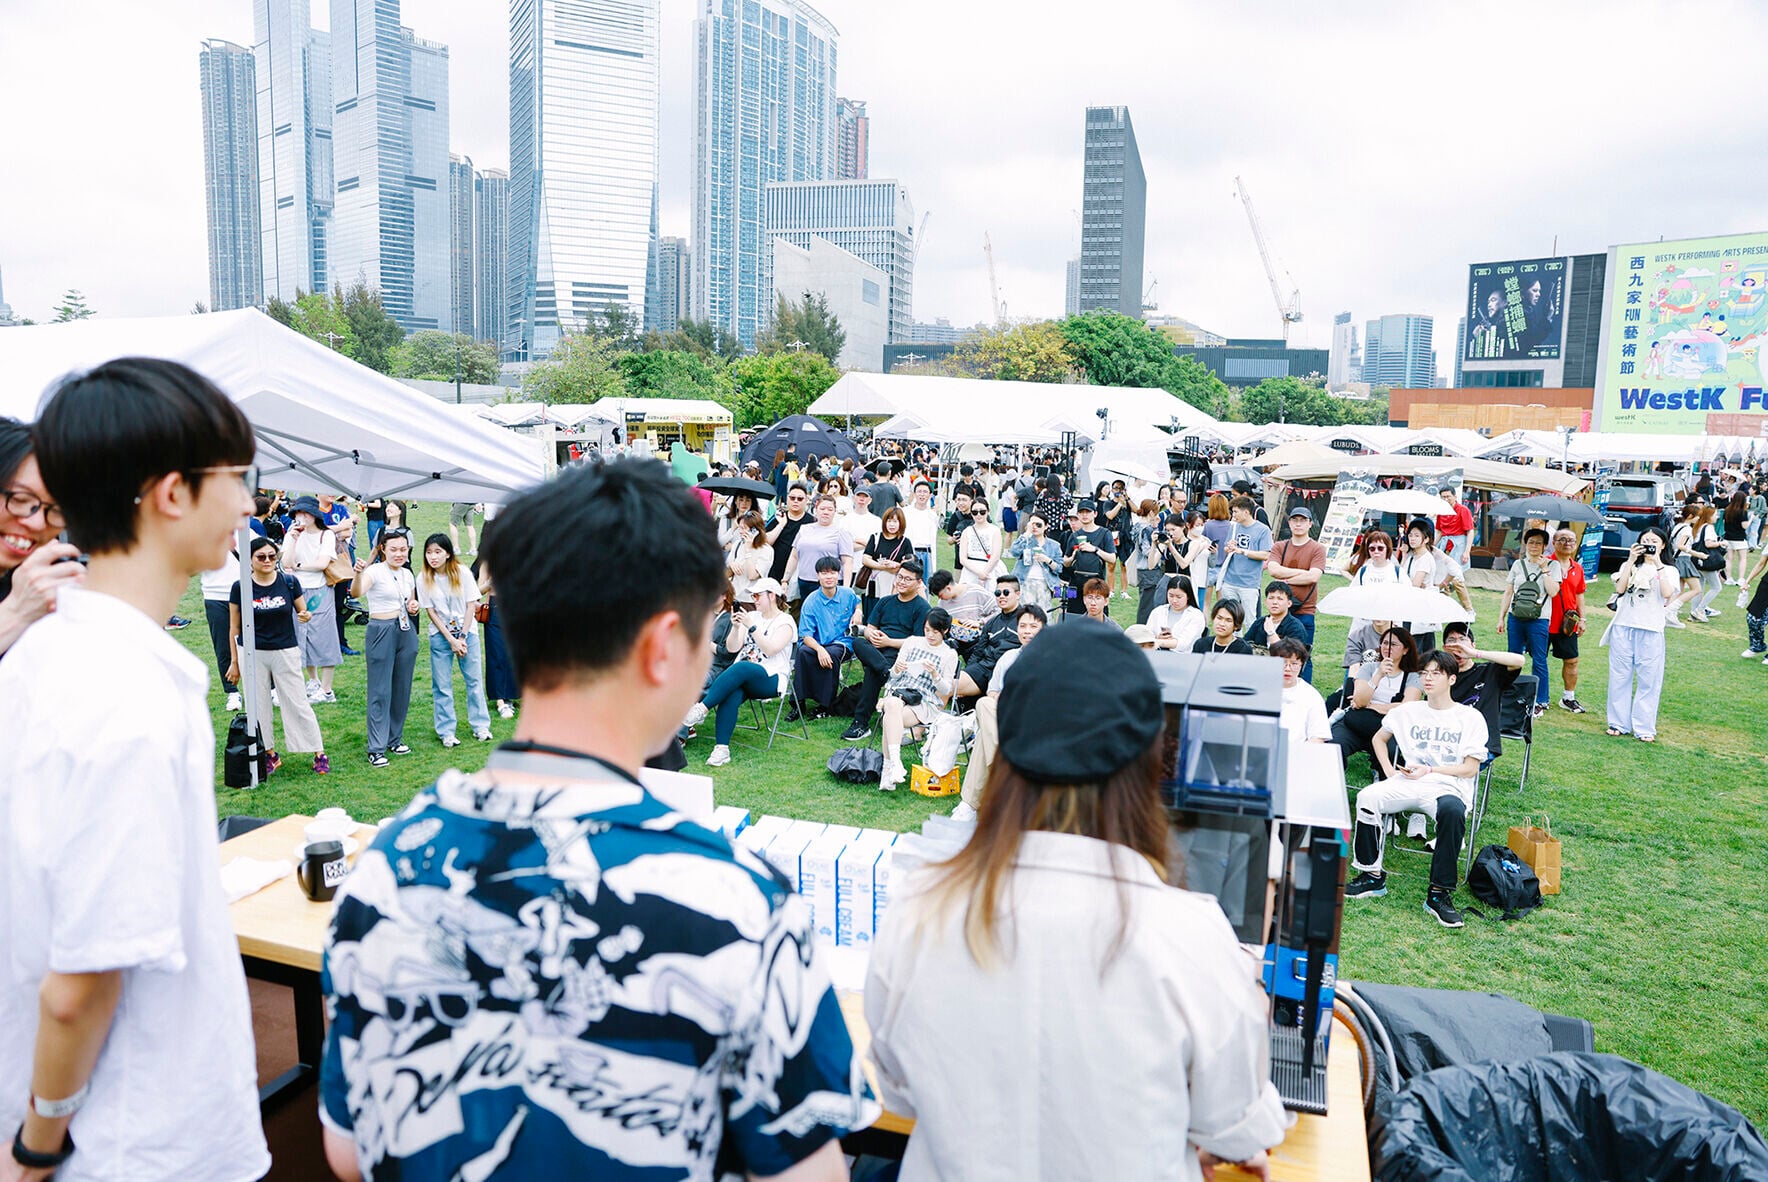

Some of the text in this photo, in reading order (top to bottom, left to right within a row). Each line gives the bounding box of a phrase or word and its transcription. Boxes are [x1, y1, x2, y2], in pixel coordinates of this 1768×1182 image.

[1654, 253, 1676, 262] WESTK
[1678, 249, 1721, 260] PERFORMING
[1722, 246, 1741, 257] ARTS
[1619, 387, 1726, 411] WestK
[1410, 725, 1462, 745] Get Lost
